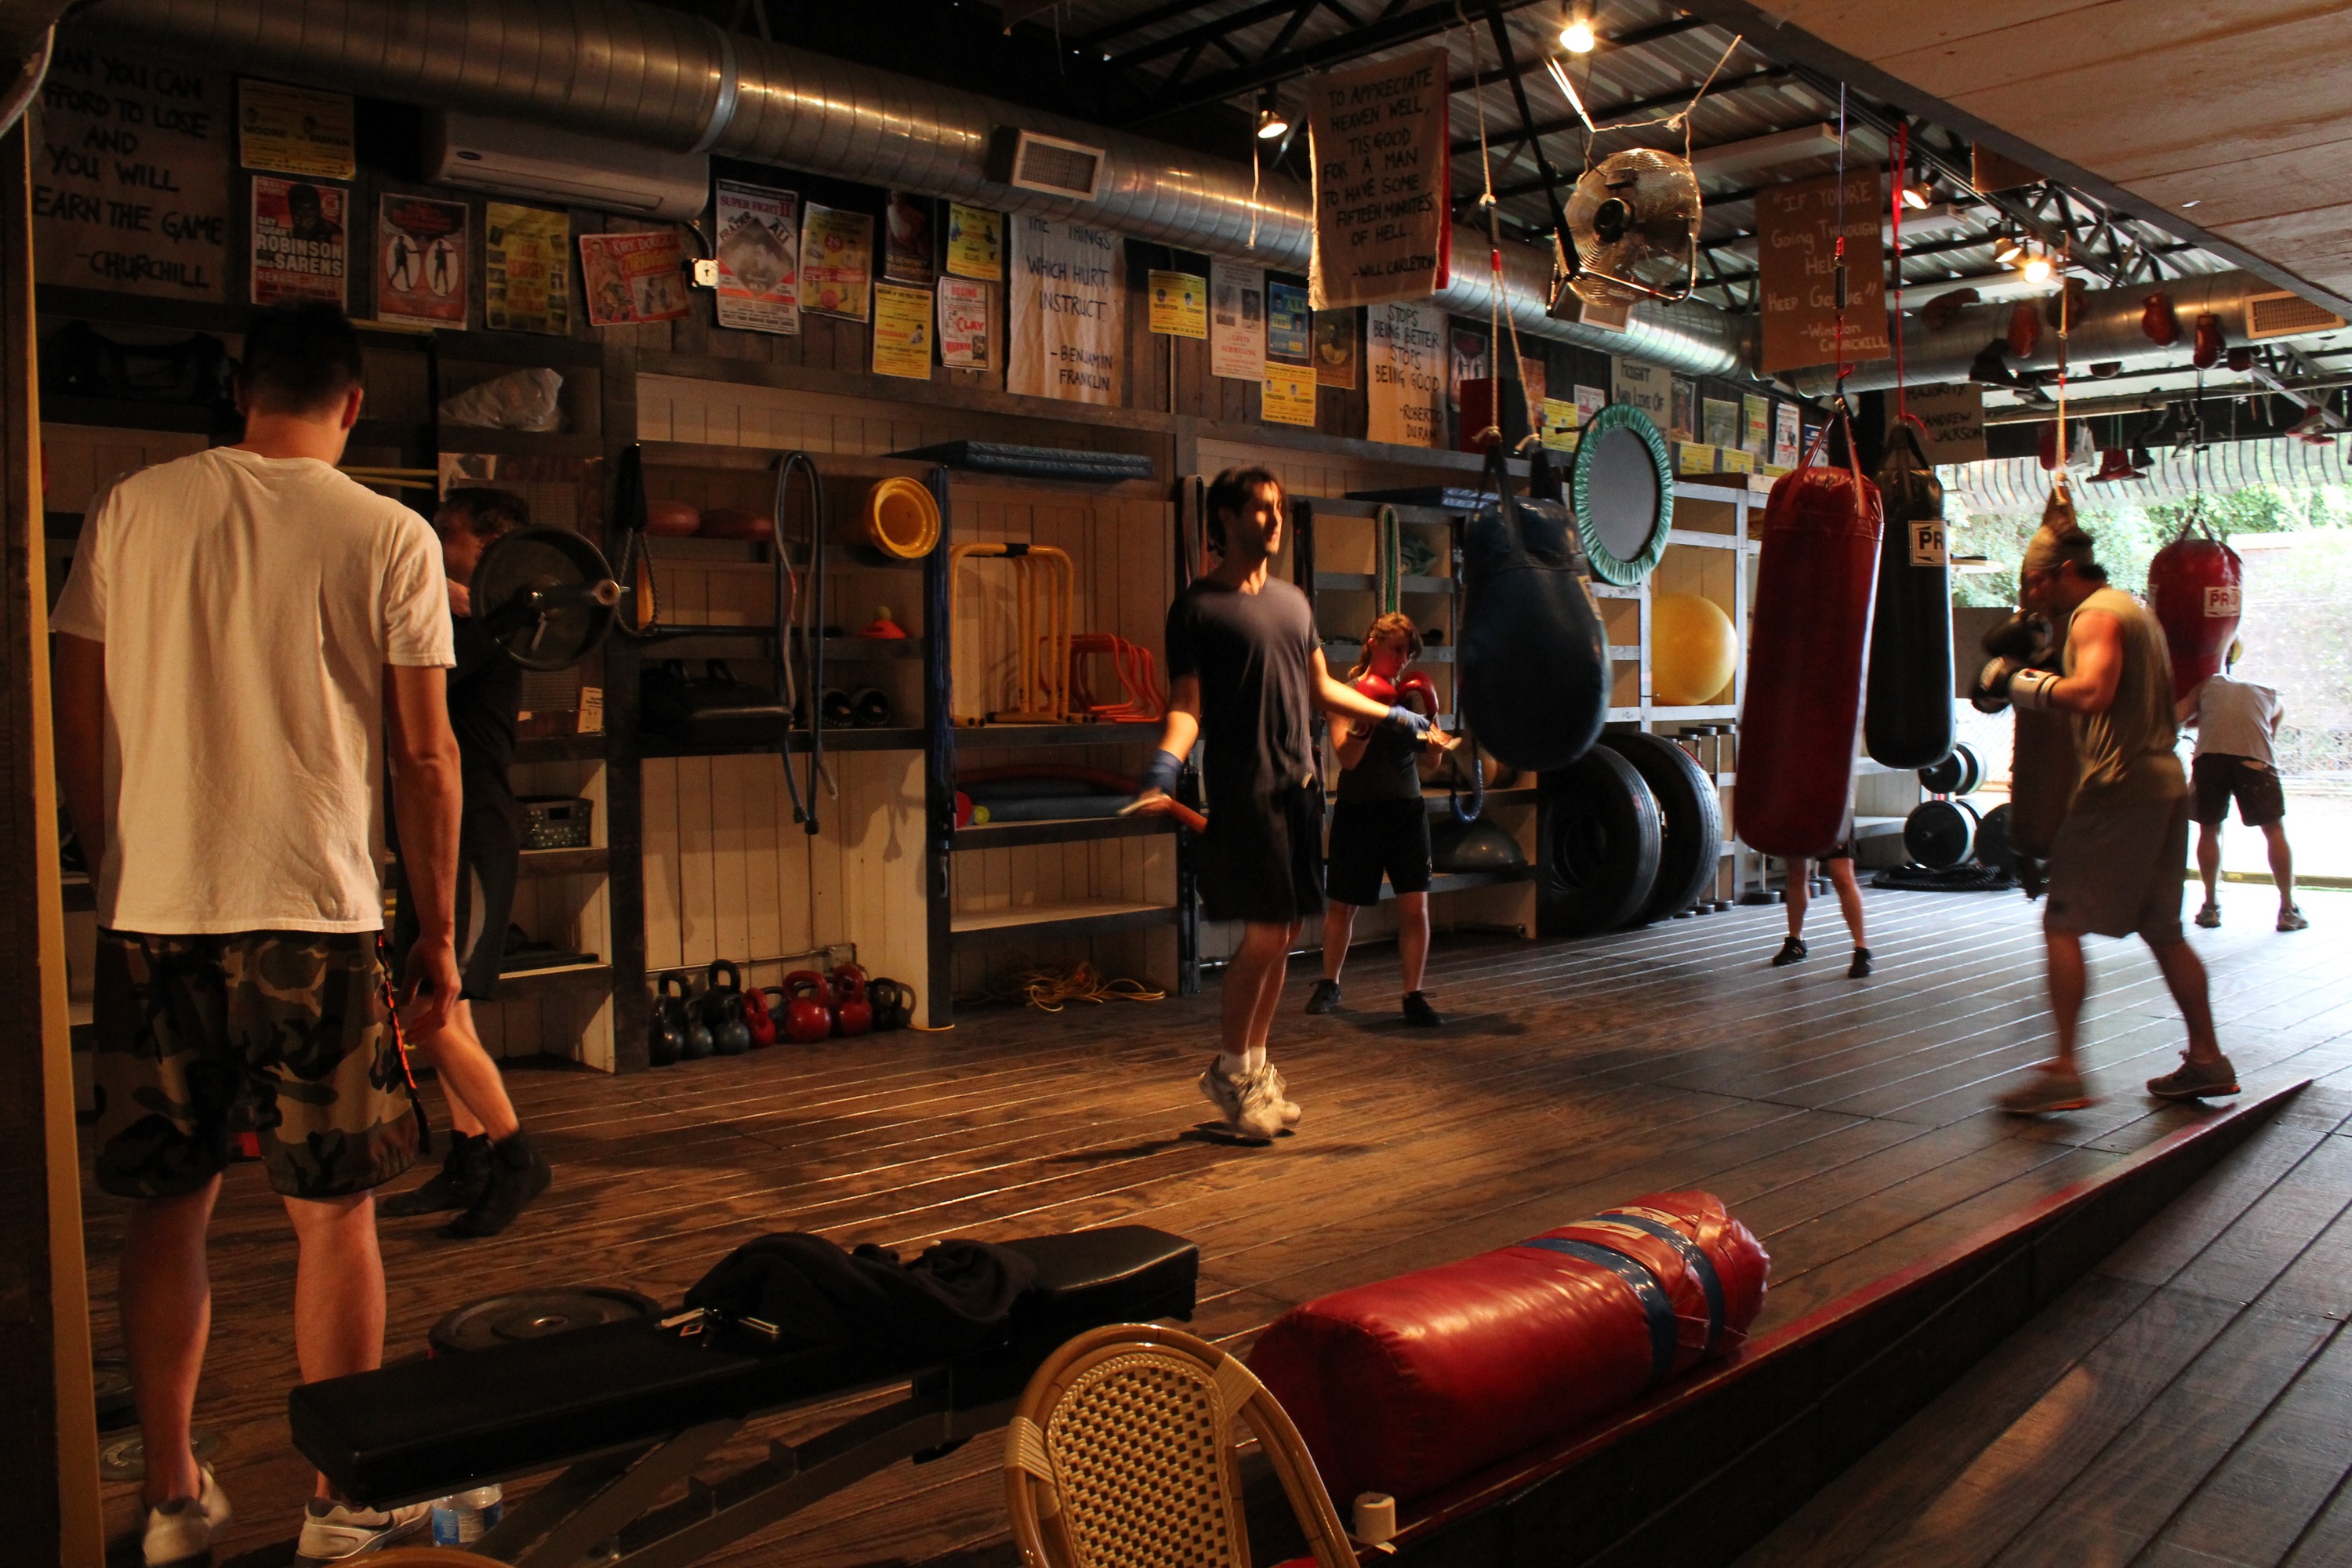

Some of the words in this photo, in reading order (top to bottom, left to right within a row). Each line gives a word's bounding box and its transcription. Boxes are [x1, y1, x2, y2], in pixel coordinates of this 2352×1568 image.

[101, 56, 147, 89] YOU
[154, 70, 201, 99] CAN
[1328, 89, 1345, 109] TO
[1351, 67, 1432, 103] APPRECIATE
[44, 83, 109, 116] FFORD
[115, 97, 143, 124] TO
[154, 103, 208, 139] LOSE
[1331, 105, 1380, 133] HEAVEN
[1389, 96, 1430, 118] WELL,
[84, 125, 138, 155] AND
[1348, 134, 1370, 156] TIS
[1374, 128, 1411, 149] GOOD
[45, 143, 100, 180] YOU
[115, 162, 180, 193] WILL
[1323, 160, 1348, 184] FOR
[1362, 156, 1372, 175] A
[1385, 146, 1418, 170] MAN
[1323, 190, 1338, 209] TO
[1345, 177, 1376, 204] HAVE
[1381, 172, 1420, 194] SOME
[34, 184, 100, 223] EARN
[107, 201, 151, 232] THE
[162, 210, 224, 245] GAME
[720, 195, 750, 209] SUPER
[752, 200, 779, 214] FIGHT
[779, 201, 791, 218] II
[1337, 202, 1381, 228] FIFTEEN
[768, 222, 789, 244] ALI
[1351, 230, 1368, 246] OF
[257, 234, 343, 260] ROBINSON
[612, 238, 637, 256] KIRK
[274, 252, 343, 278] SARENS
[1026, 255, 1066, 281] WHICH
[1073, 266, 1109, 293] HURT,
[1387, 255, 1436, 275] CARLETON
[956, 316, 985, 333] CLAY
[1388, 304, 1418, 327] STOPS
[1374, 320, 1400, 339] BEING
[1404, 327, 1440, 348] BETTER
[1391, 345, 1421, 370] STOPS
[1060, 369, 1109, 391] FRANKLIN
[1376, 365, 1404, 388] BEING
[1411, 373, 1439, 392] GOOD
[1406, 424, 1438, 441] DURAN
[1933, 426, 1982, 441] JACKSON
